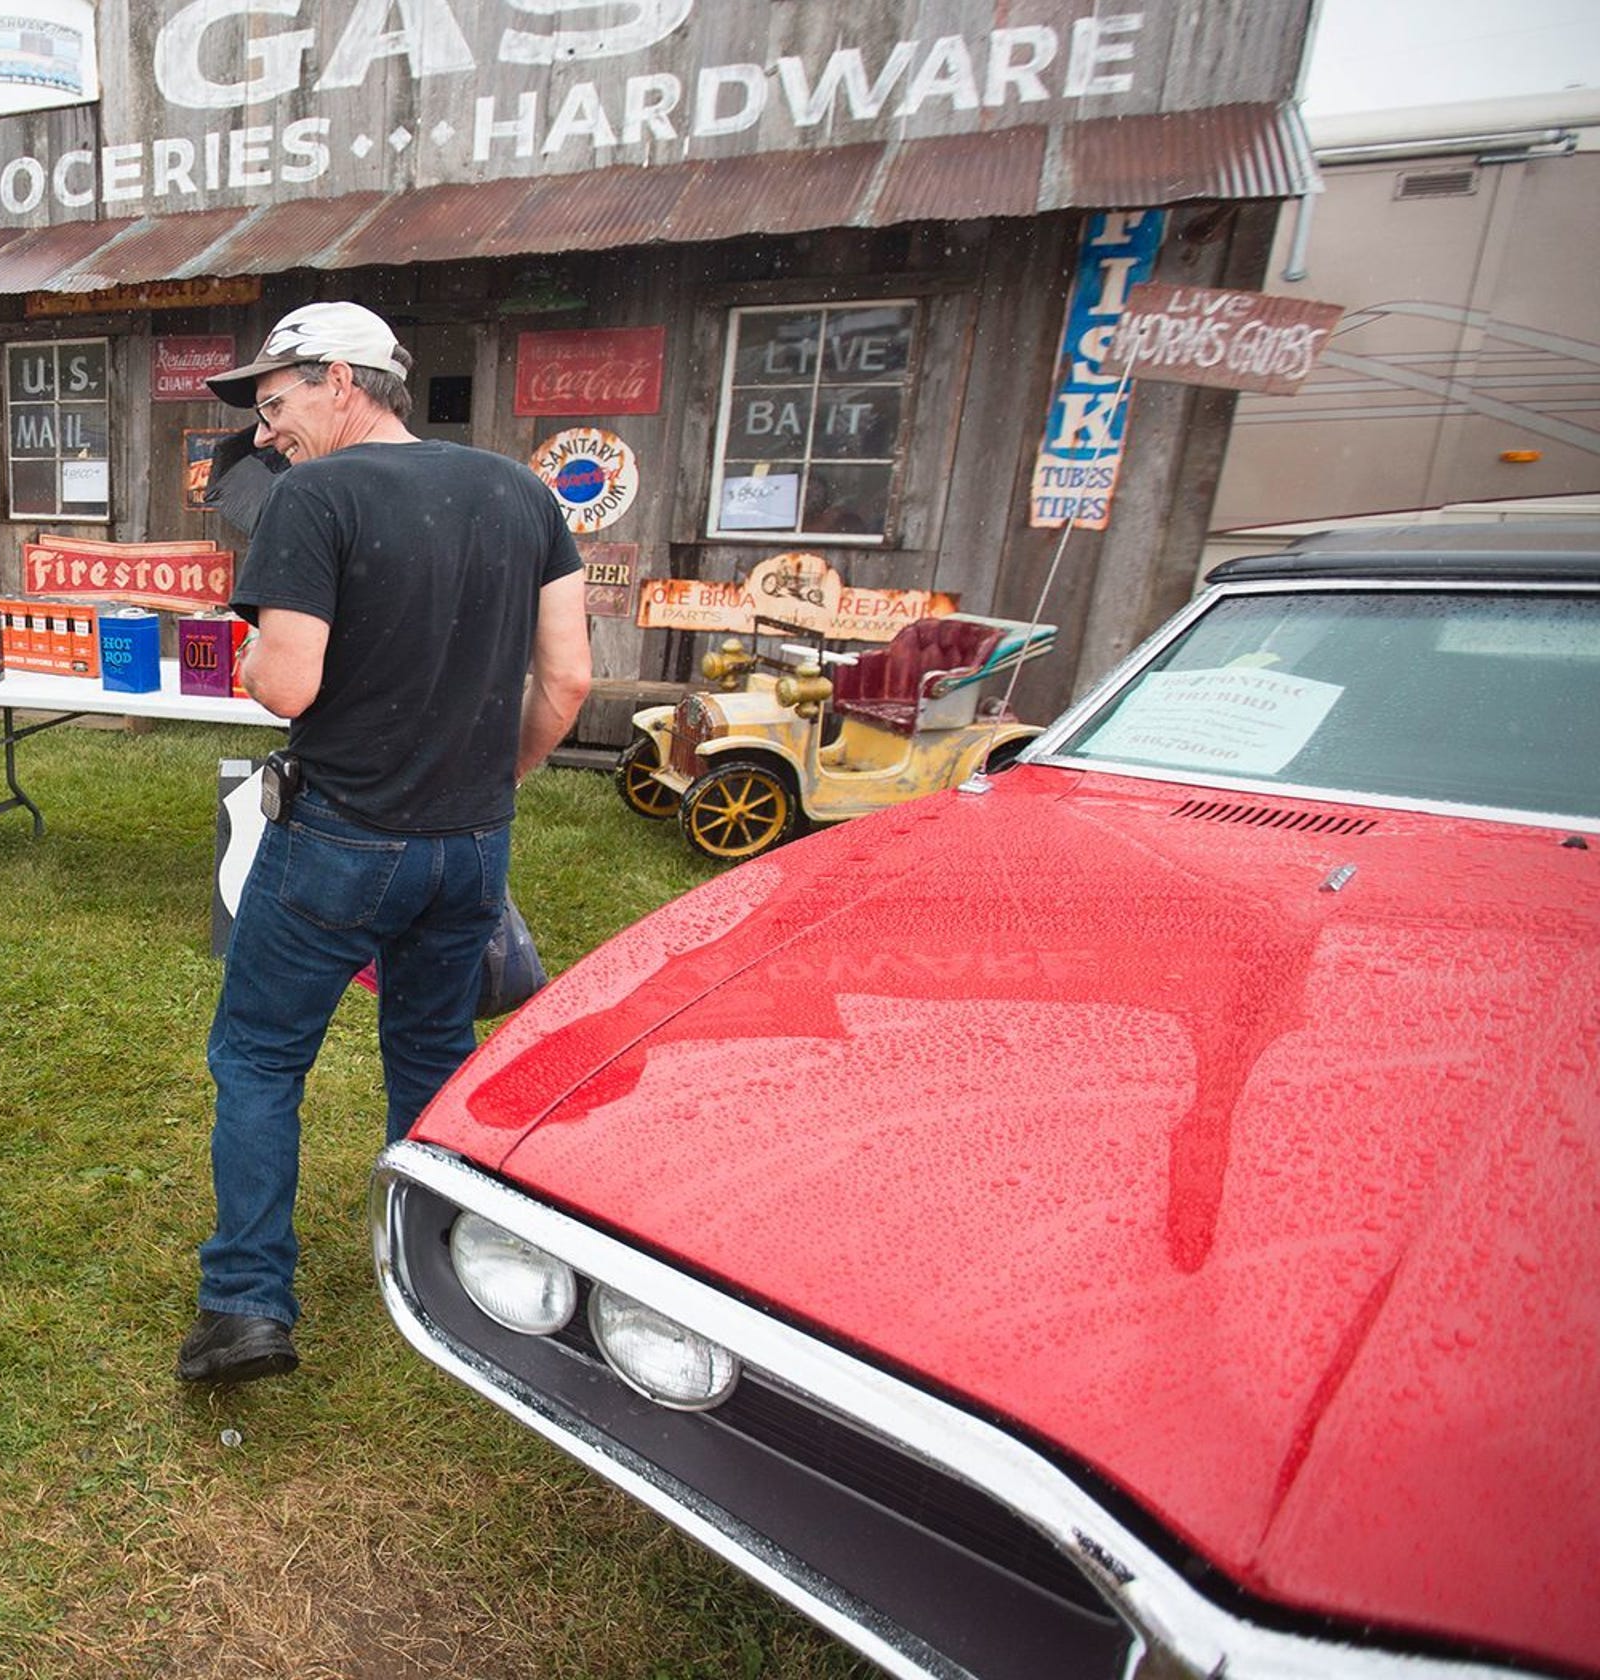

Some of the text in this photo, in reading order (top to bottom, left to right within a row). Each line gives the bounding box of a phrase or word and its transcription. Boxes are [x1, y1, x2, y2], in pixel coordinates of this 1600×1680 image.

[472, 13, 1144, 162] HARDWARE
[765, 337, 888, 374] LIVE
[1111, 311, 1231, 367] WORMS
[17, 414, 91, 449] MAIL
[746, 401, 874, 436] BAIT
[540, 438, 620, 471] SANITARY
[1040, 466, 1114, 488] TUBES
[584, 485, 626, 523] ROOM
[1036, 496, 1108, 520] TIRES
[28, 549, 228, 594] Firestone
[651, 587, 692, 606] OLE
[837, 594, 934, 618] REPAIR
[661, 608, 722, 623] PARTS
[103, 637, 133, 650] HOT
[104, 651, 133, 664] ROD
[184, 641, 218, 670] OIL
